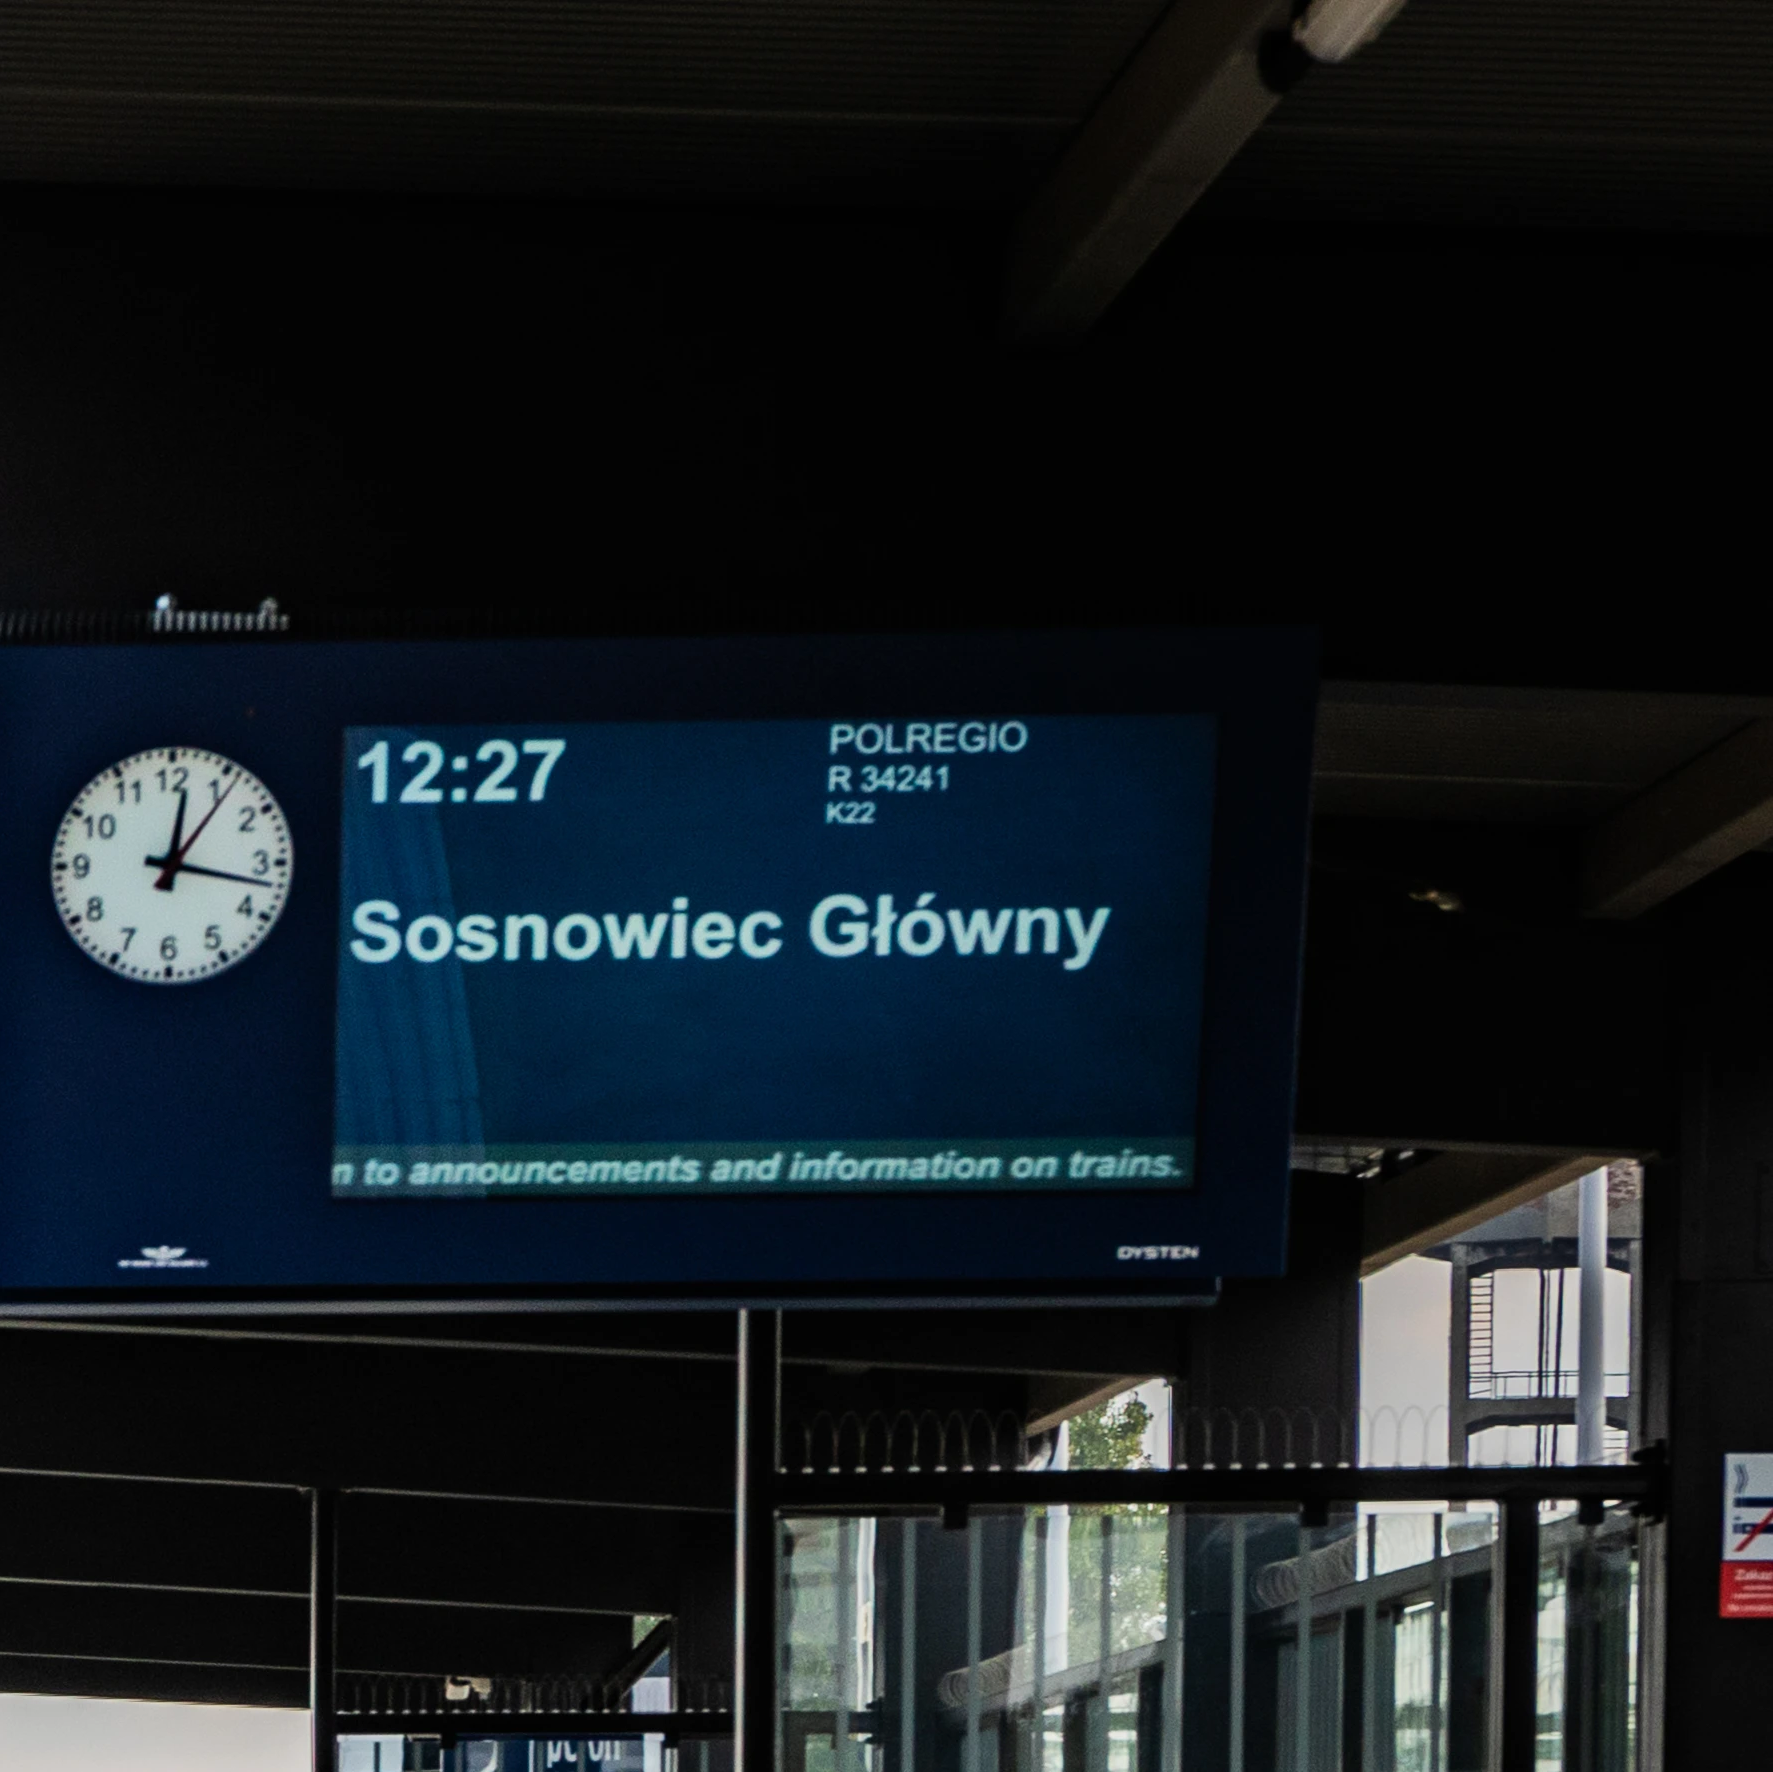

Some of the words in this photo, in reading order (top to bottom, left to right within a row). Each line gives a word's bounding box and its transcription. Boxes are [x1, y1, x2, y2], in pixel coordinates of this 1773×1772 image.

[829, 720, 1028, 755] POLREGIO
[156, 767, 189, 794] 12
[357, 739, 566, 803] 12:27
[828, 765, 852, 792] R
[860, 764, 950, 793] 34241
[115, 781, 142, 803] 11
[209, 780, 221, 802] 1
[239, 806, 256, 833] 2
[825, 801, 876, 824] K22
[83, 814, 116, 839] 10
[72, 853, 90, 879] 9
[253, 850, 270, 876] 3
[86, 897, 103, 922] 8
[236, 894, 252, 918] 4
[120, 927, 137, 952] 7
[205, 925, 221, 950] 5
[350, 898, 782, 963] Sosnowiec
[809, 893, 1111, 970] Główny
[160, 936, 177, 961] 6
[363, 1157, 400, 1186] to
[408, 1155, 701, 1186] announcements
[709, 1150, 783, 1184] and
[788, 1150, 1000, 1181] information
[1010, 1155, 1058, 1180] on
[1068, 1147, 1183, 1179] trains.
